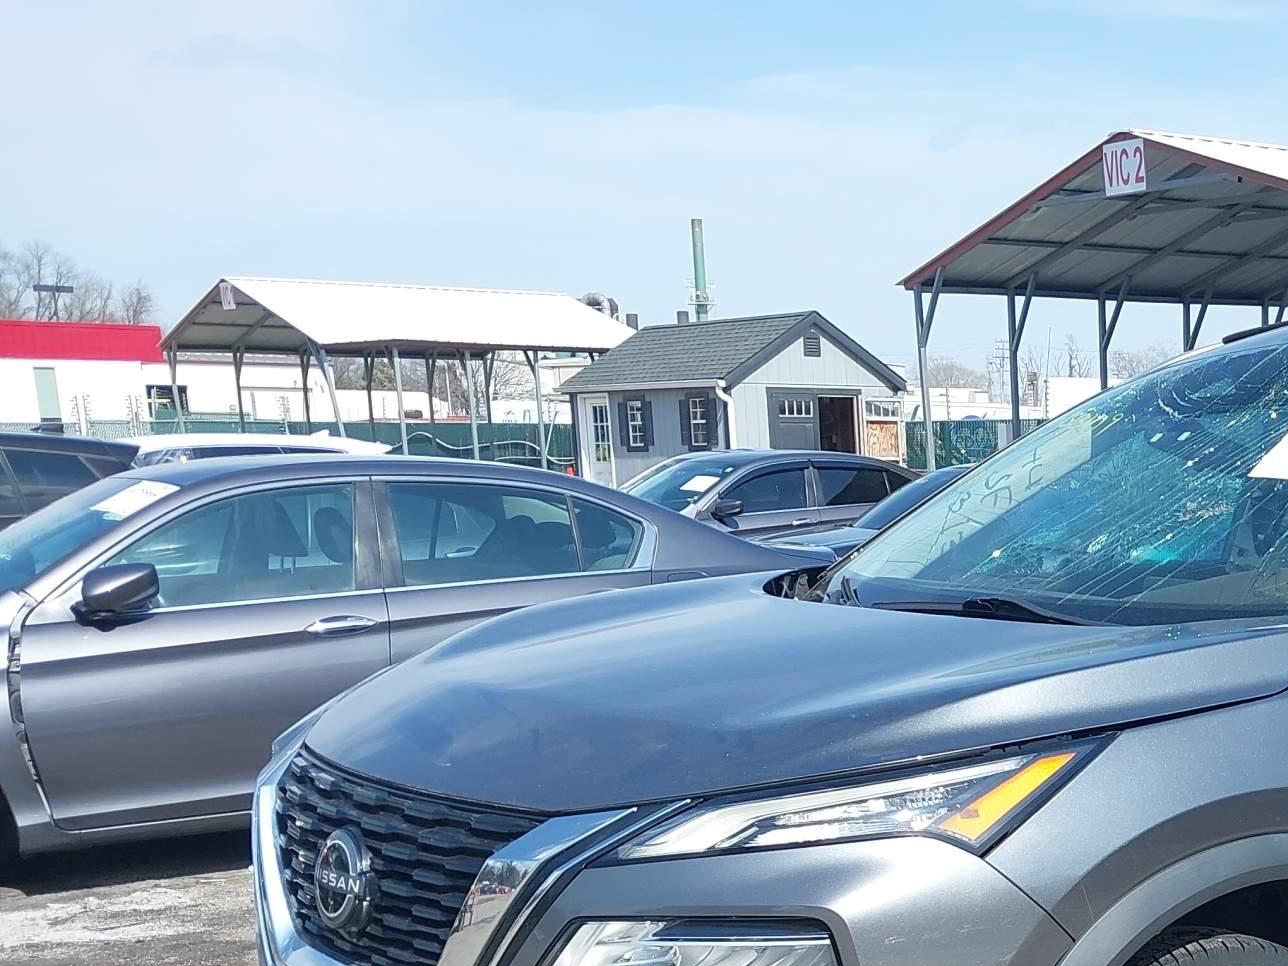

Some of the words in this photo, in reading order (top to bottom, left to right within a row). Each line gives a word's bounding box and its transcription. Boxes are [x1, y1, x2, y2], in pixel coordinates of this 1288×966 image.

[1103, 147, 1131, 188] VIC
[1133, 145, 1145, 184] 2
[319, 869, 360, 893] ISSAN
